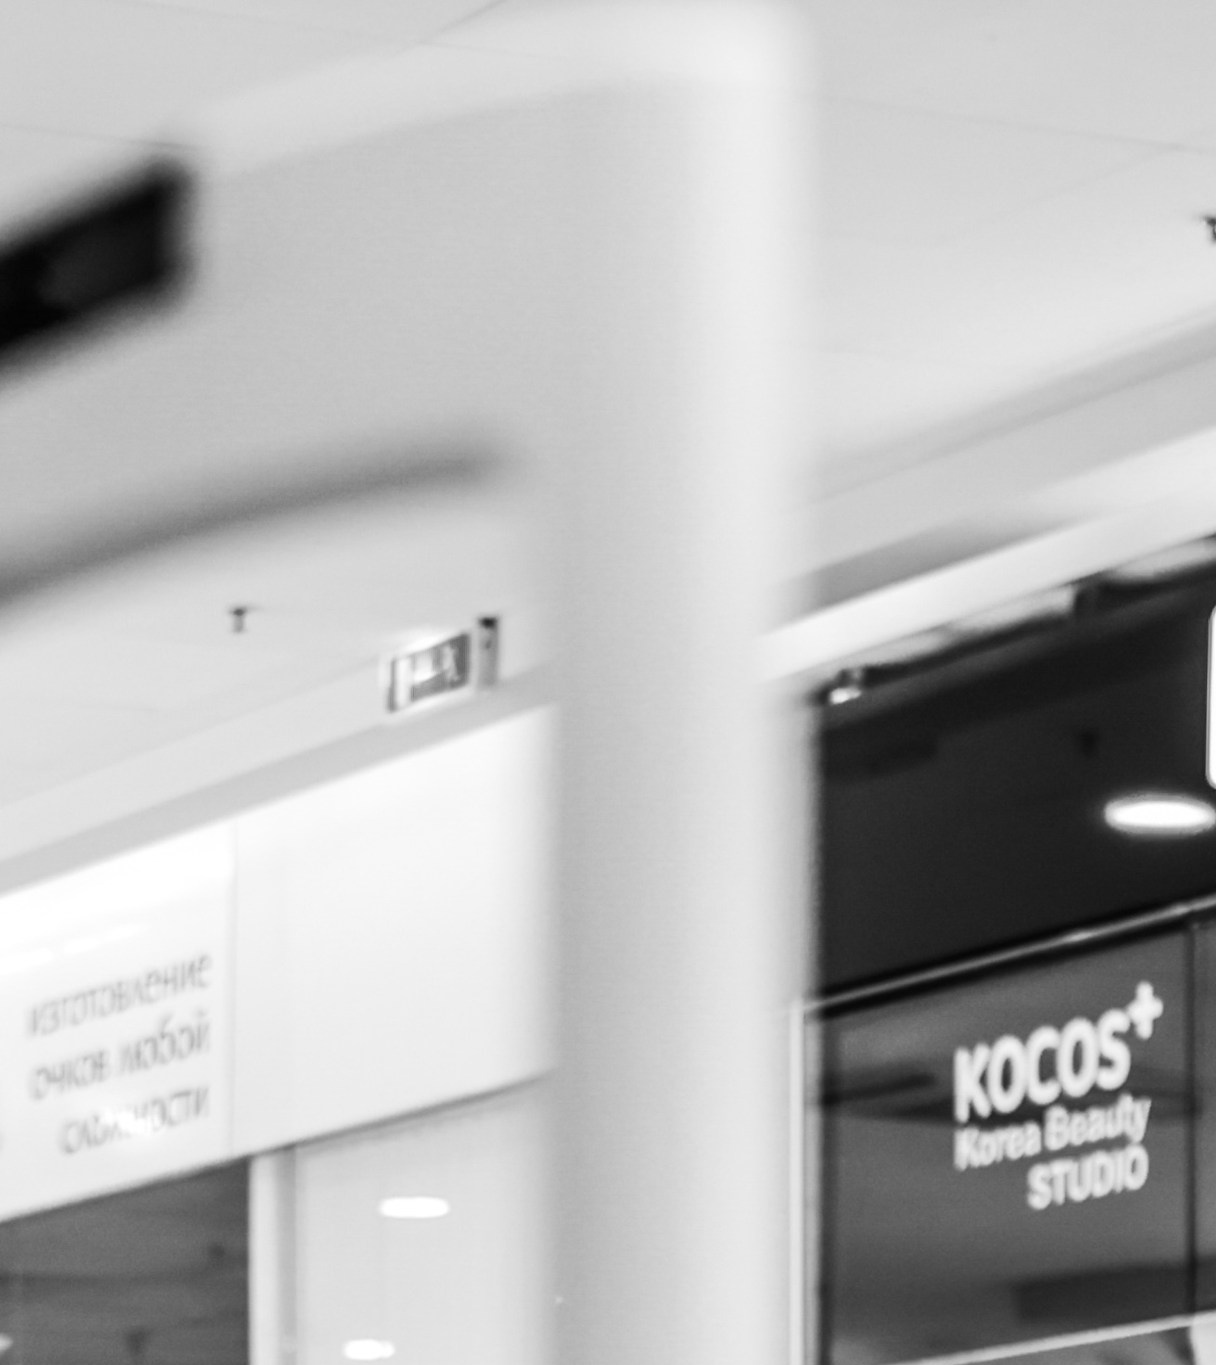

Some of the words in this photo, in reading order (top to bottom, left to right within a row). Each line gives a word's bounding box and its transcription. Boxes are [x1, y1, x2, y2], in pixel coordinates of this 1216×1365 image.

[954, 1122, 1042, 1171] Korea
[1044, 1094, 1152, 1152] Beauty
[1027, 1143, 1150, 1210] STUDIO
